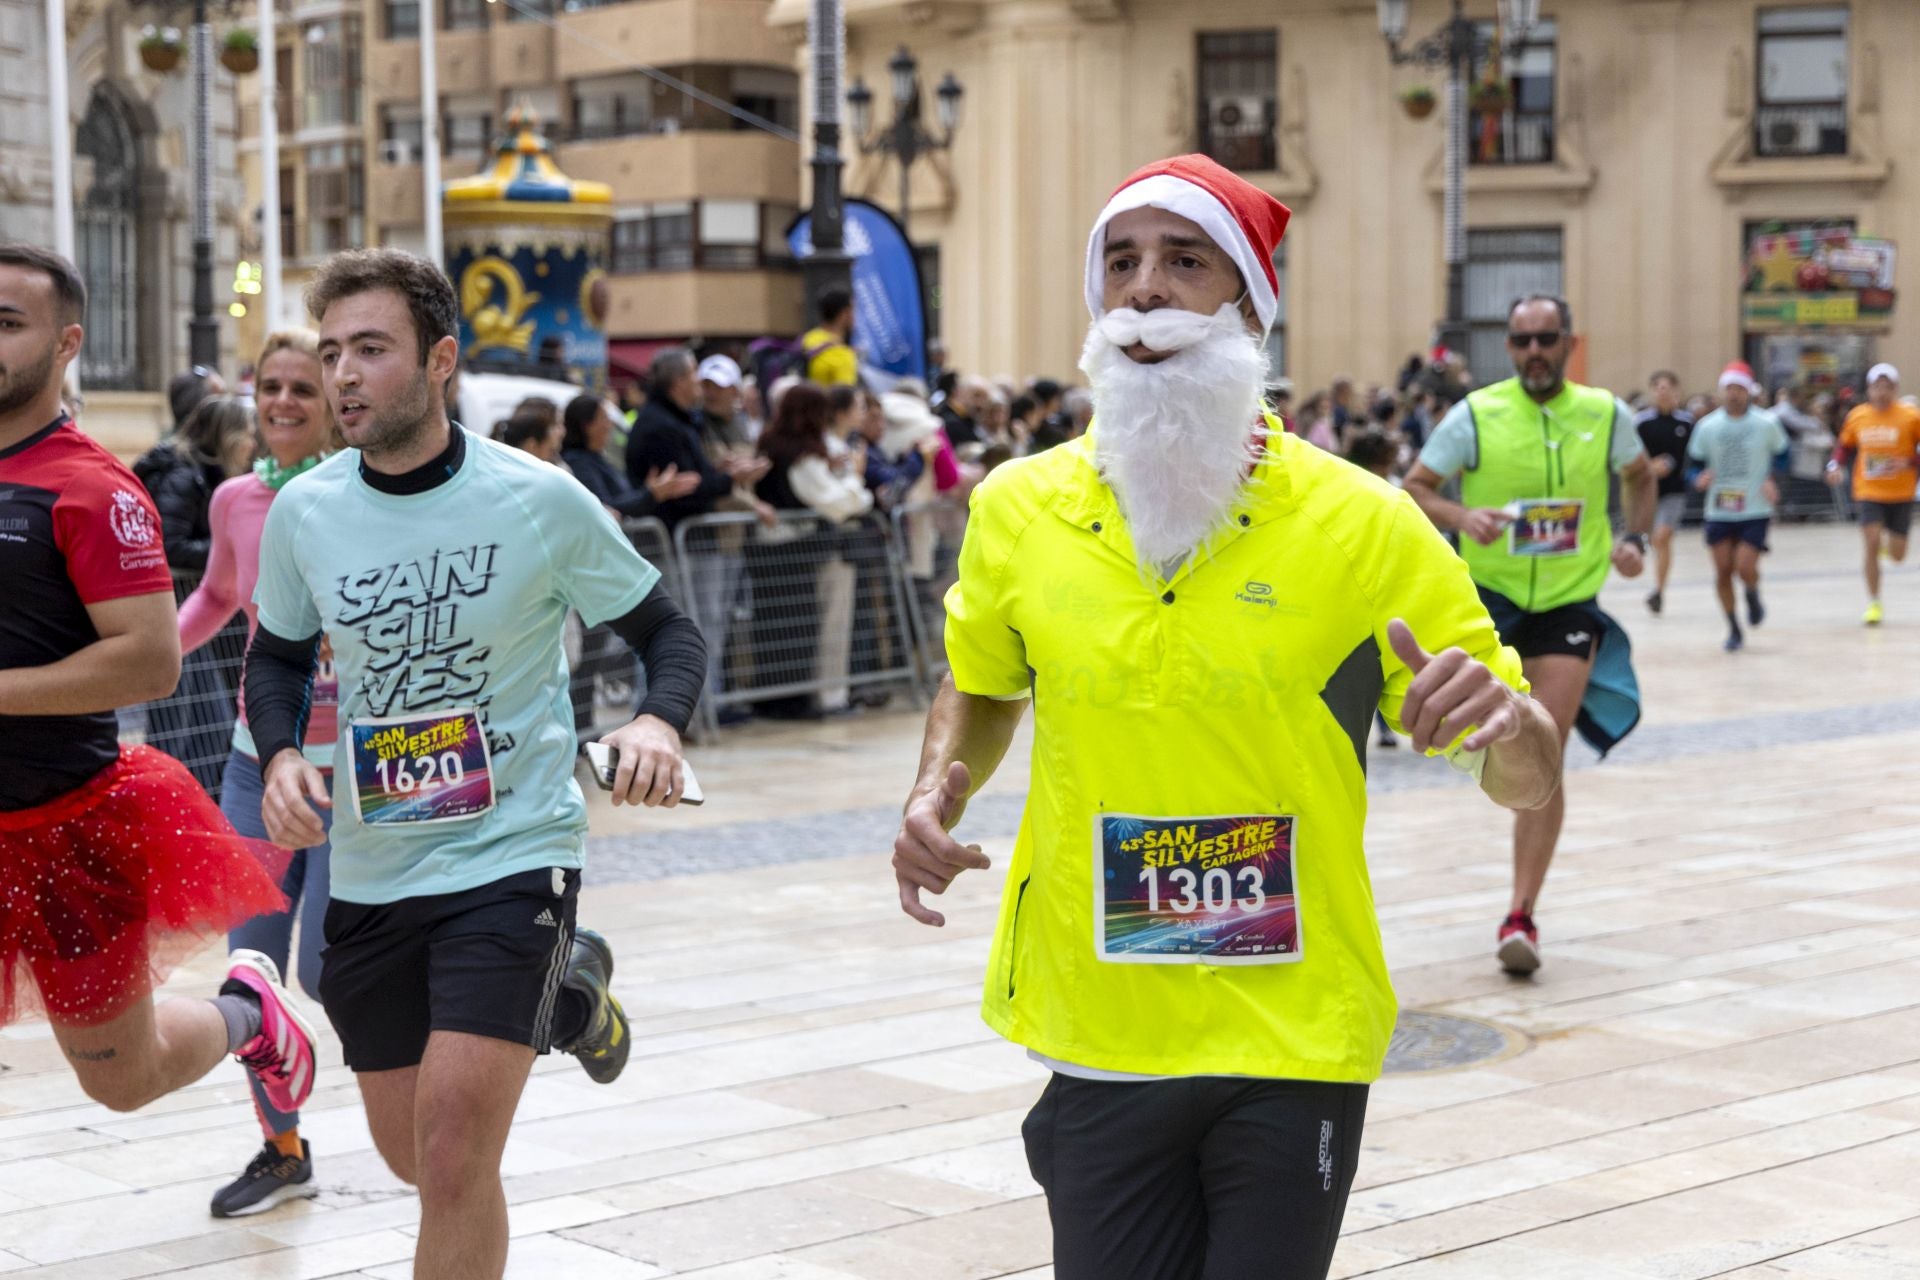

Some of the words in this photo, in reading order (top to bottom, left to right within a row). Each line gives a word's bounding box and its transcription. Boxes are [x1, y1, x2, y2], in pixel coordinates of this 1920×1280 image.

[336, 543, 501, 625] SAN
[357, 603, 474, 673] SIL
[356, 646, 492, 717] VES
[373, 725, 406, 749] SAN
[377, 717, 466, 762] SILVESTRE
[412, 732, 469, 760] CARTAGENA
[375, 751, 465, 794] 1620
[1142, 820, 1278, 870] SILVESTRE
[1143, 824, 1198, 850] SAN
[1201, 839, 1276, 871] CARTAGENA
[1139, 865, 1267, 915] 1303
[534, 918, 557, 927] adidas
[1318, 1120, 1327, 1172] MOTION
[1324, 1153, 1332, 1190] CTRL
